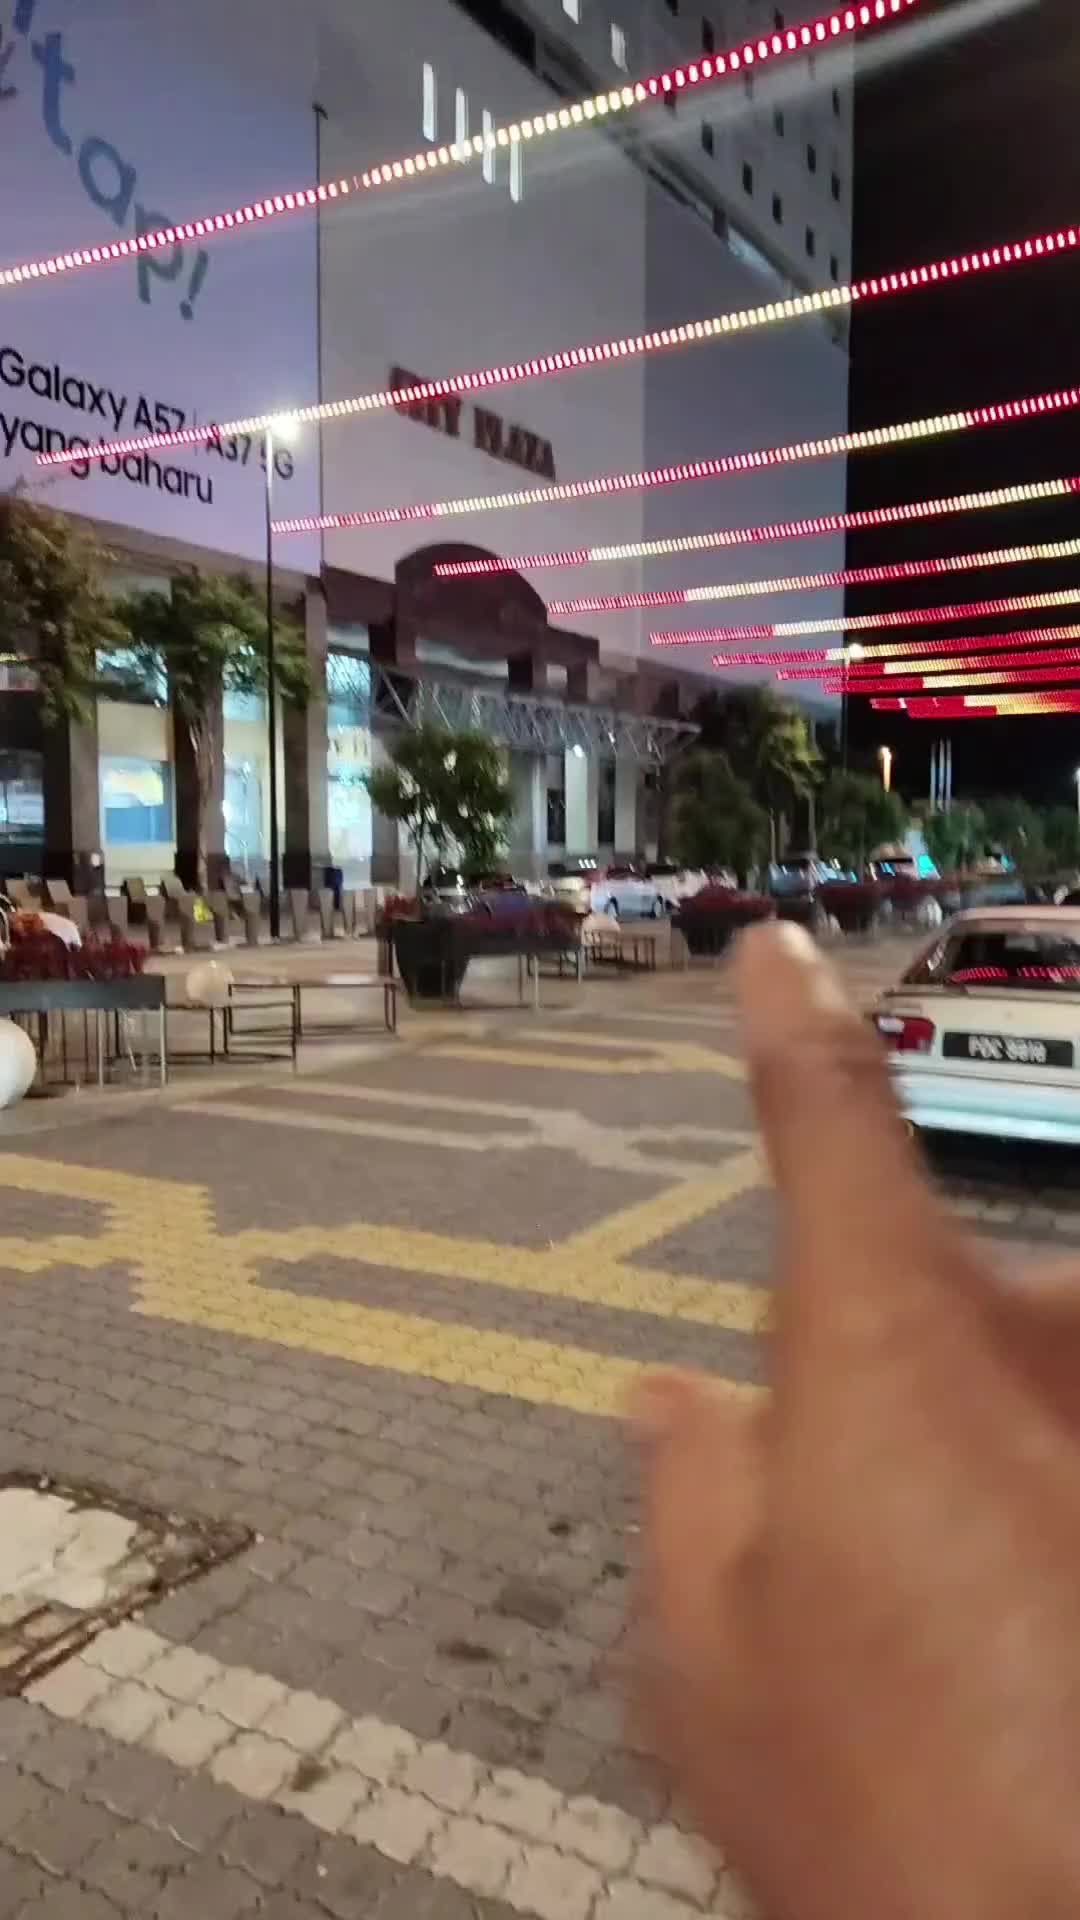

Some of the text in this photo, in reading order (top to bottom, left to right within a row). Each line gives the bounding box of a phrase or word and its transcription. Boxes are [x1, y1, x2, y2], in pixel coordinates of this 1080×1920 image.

[0, 346, 127, 432] Galaxy
[134, 393, 186, 436] A57
[0, 412, 214, 504] yang baharu
